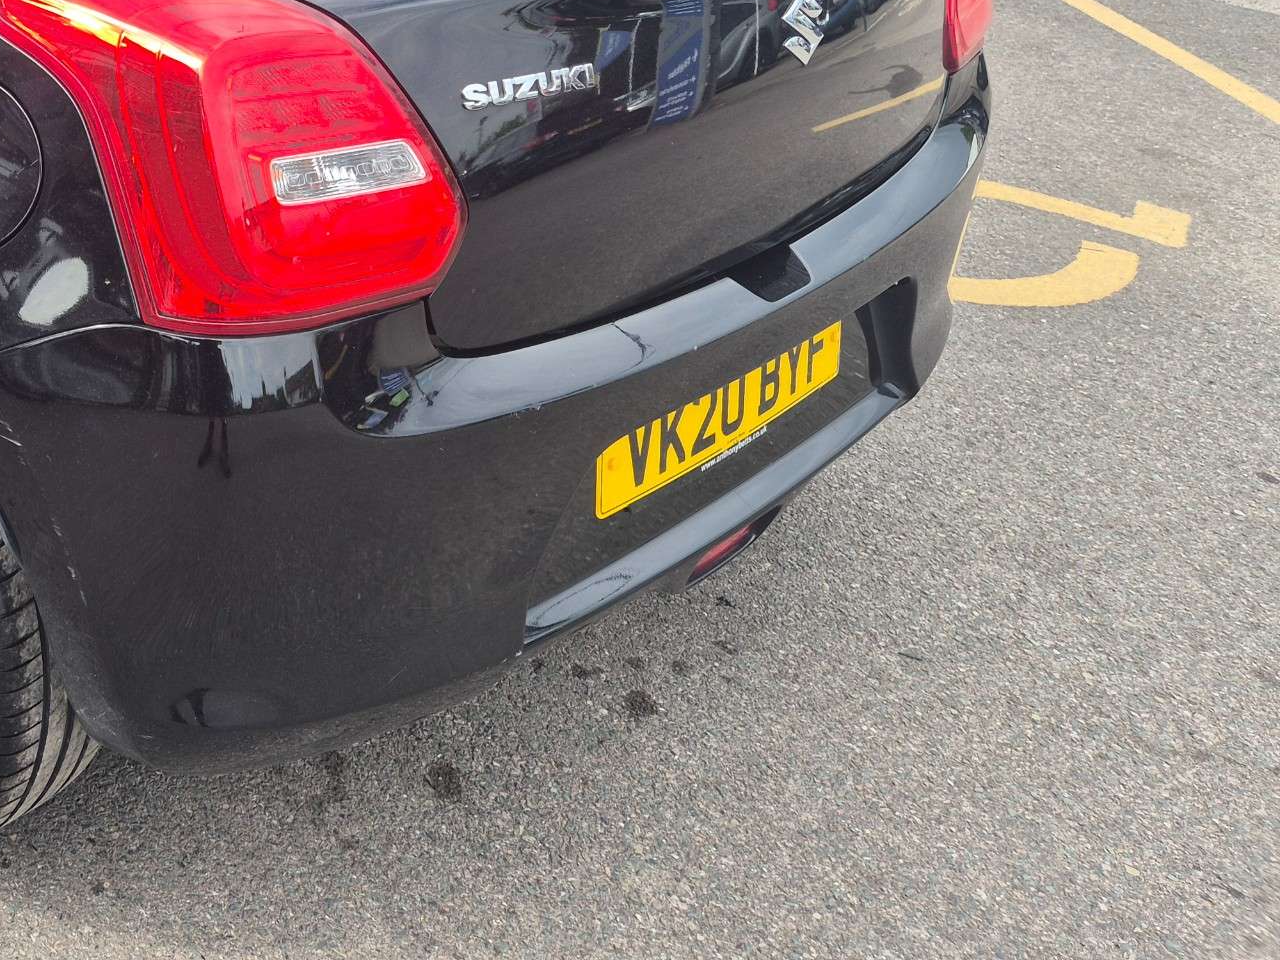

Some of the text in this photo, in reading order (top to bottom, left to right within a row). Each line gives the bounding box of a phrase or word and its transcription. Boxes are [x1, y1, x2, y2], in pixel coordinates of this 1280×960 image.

[461, 62, 597, 111] SUZUKI
[627, 335, 825, 487] VK20 BYF
